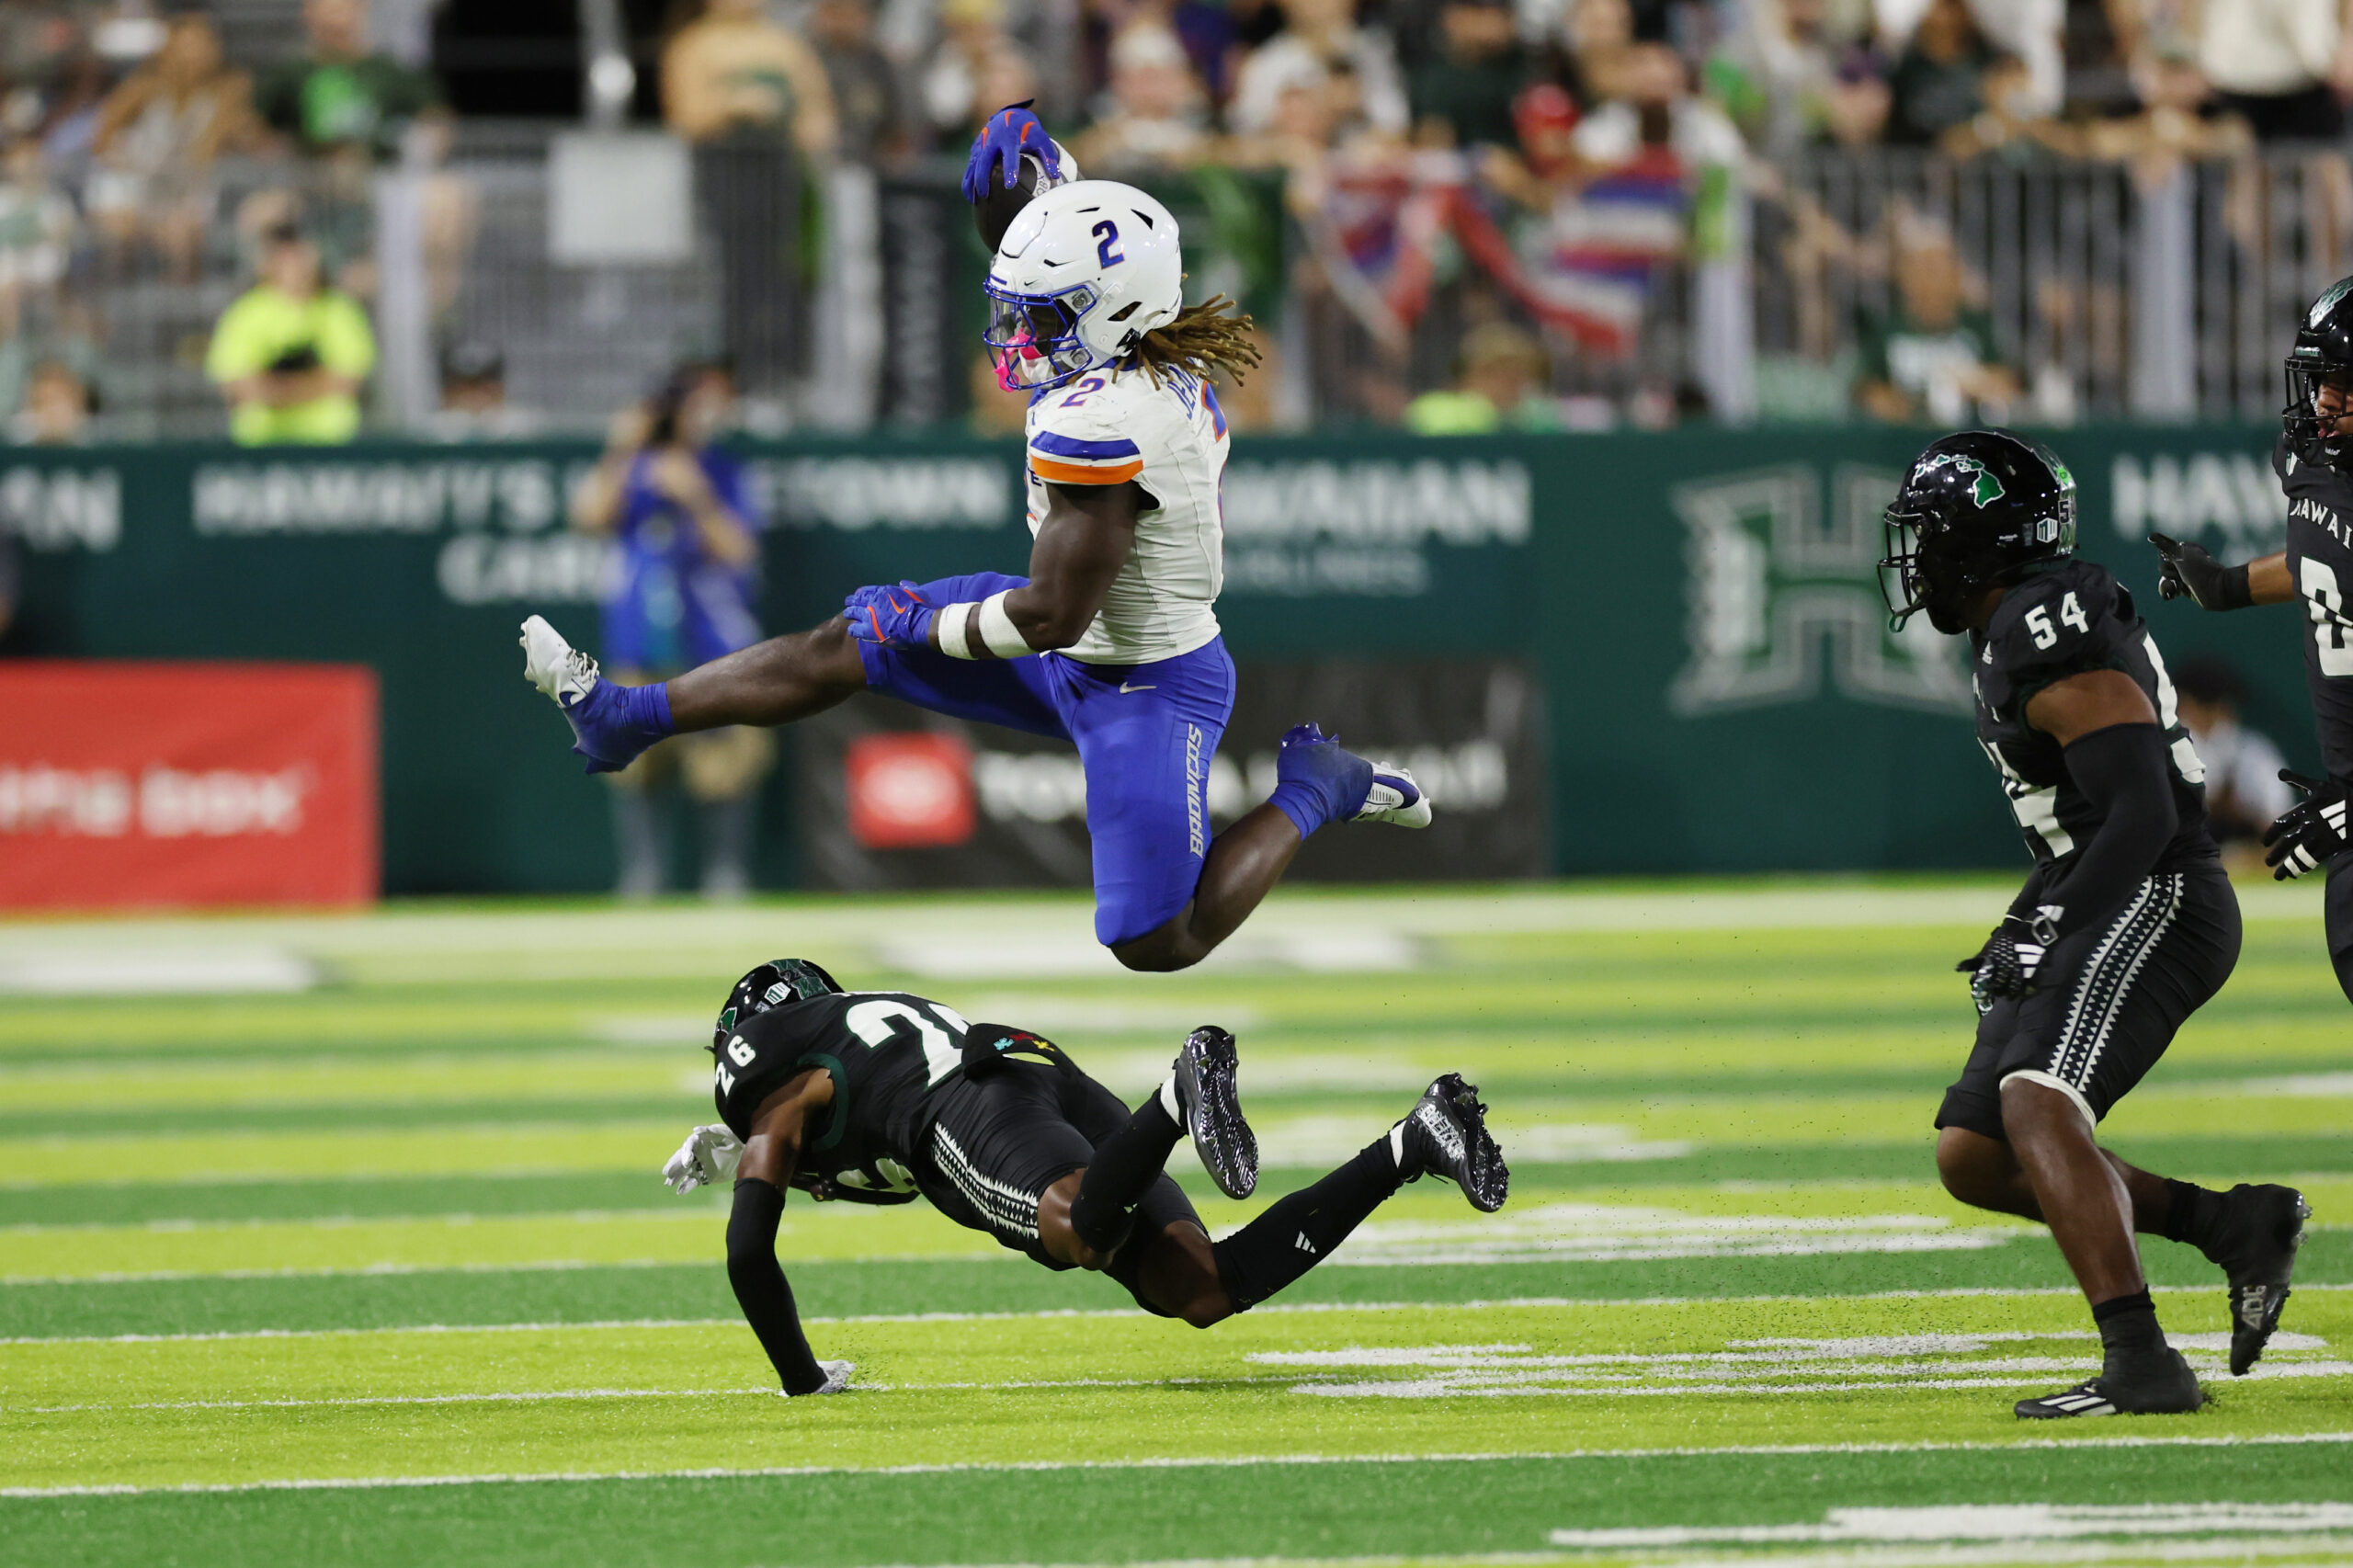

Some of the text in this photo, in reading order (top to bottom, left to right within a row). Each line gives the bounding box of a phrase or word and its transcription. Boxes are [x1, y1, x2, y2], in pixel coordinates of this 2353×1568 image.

[1092, 220, 1124, 270] 2
[1060, 378, 1106, 408] 2
[2025, 591, 2089, 651] 54
[1186, 722, 1204, 859] BRONCOS
[715, 1034, 756, 1097] 26
